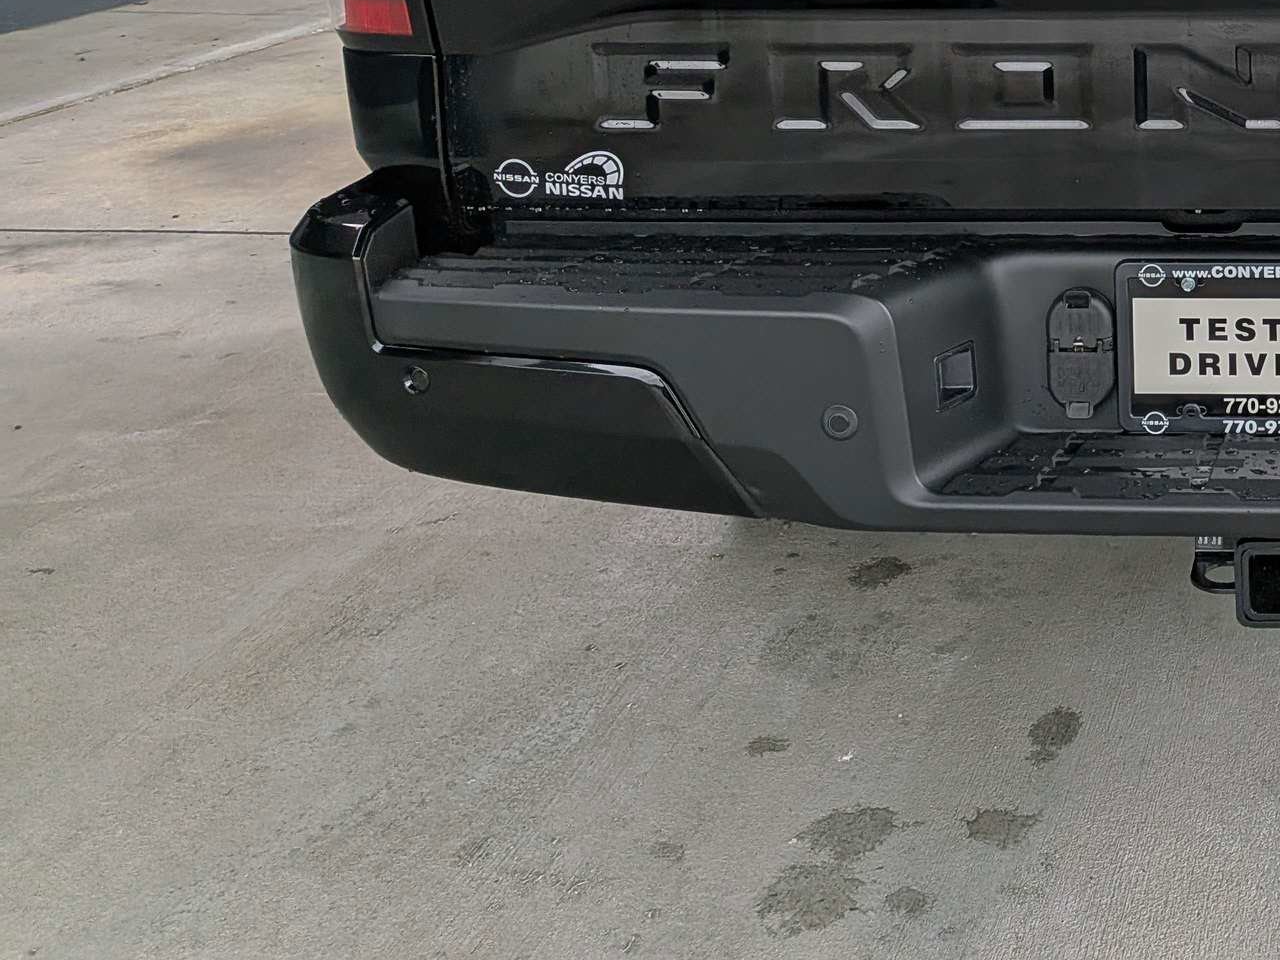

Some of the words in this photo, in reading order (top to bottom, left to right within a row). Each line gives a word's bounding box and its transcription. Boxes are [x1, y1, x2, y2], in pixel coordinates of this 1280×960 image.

[493, 173, 540, 184] NISSAN
[545, 172, 606, 186] CONYERS
[545, 182, 624, 200] NISSAN
